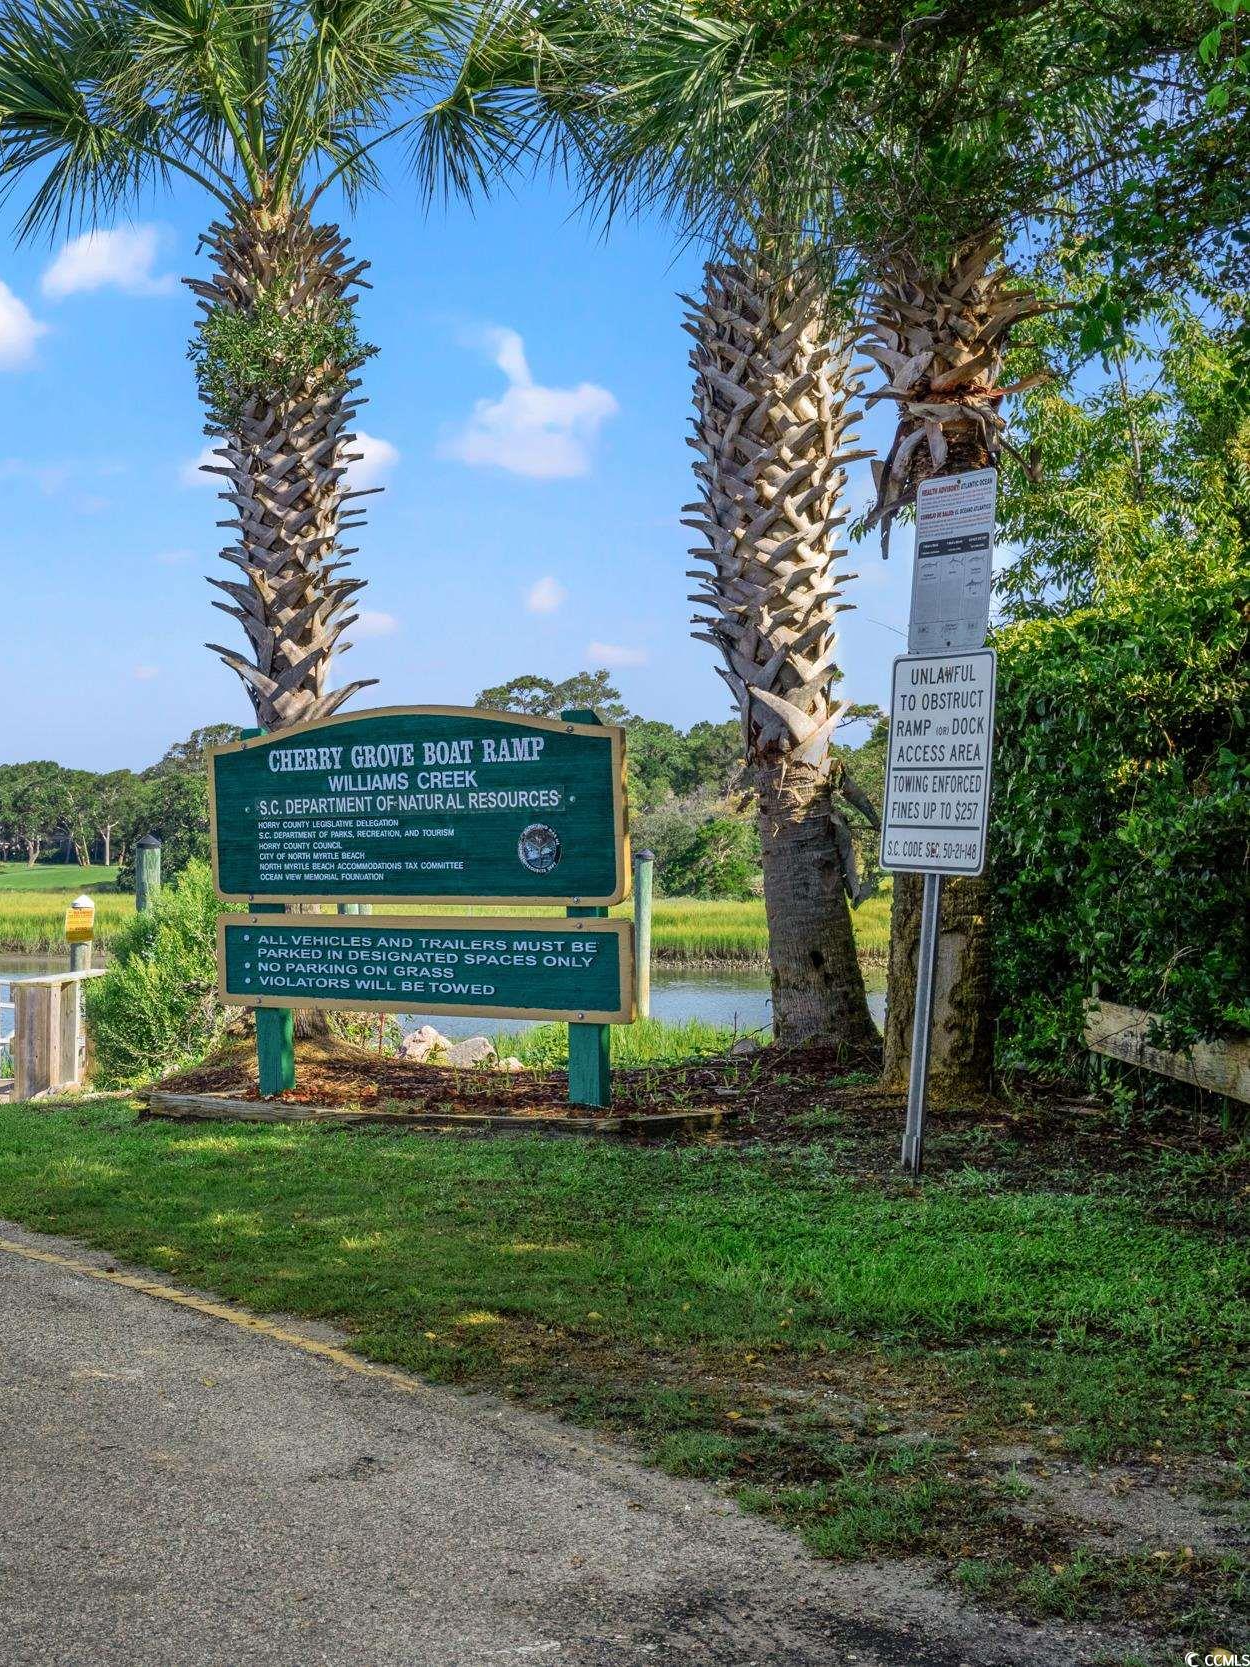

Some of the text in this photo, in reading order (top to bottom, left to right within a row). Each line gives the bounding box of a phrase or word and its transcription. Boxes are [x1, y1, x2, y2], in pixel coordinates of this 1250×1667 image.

[911, 665, 976, 685] UNLAWFUL
[901, 690, 983, 710] TO OBSTRUCT
[897, 717, 984, 736] RAMP (OR) DOCK
[269, 737, 544, 772] CHERRY GROVE BOAT RAMP
[897, 744, 981, 762] ACCESS AREA
[328, 770, 478, 791] WILLIAMS CREEK
[894, 775, 981, 792] TOWING ENFORCED
[260, 790, 559, 815] S.C. DEPARTMENT OF NATURAL RESOURCES
[892, 801, 978, 821] FINES UP TO $257
[313, 820, 353, 828] LEGISLATIVE
[357, 819, 398, 827] DELEGATION
[888, 841, 976, 859] S.C. CODE SEC. 50-21-148
[258, 935, 597, 952] ALL VEHICLES AND TRAILERS MUST BE
[258, 949, 593, 967] PARKED IN DESIGNATED SPACES ONLY
[258, 963, 454, 979] NO PARKING ON GRASS
[260, 976, 495, 995] VIOLATORS WILL BE TOWED
